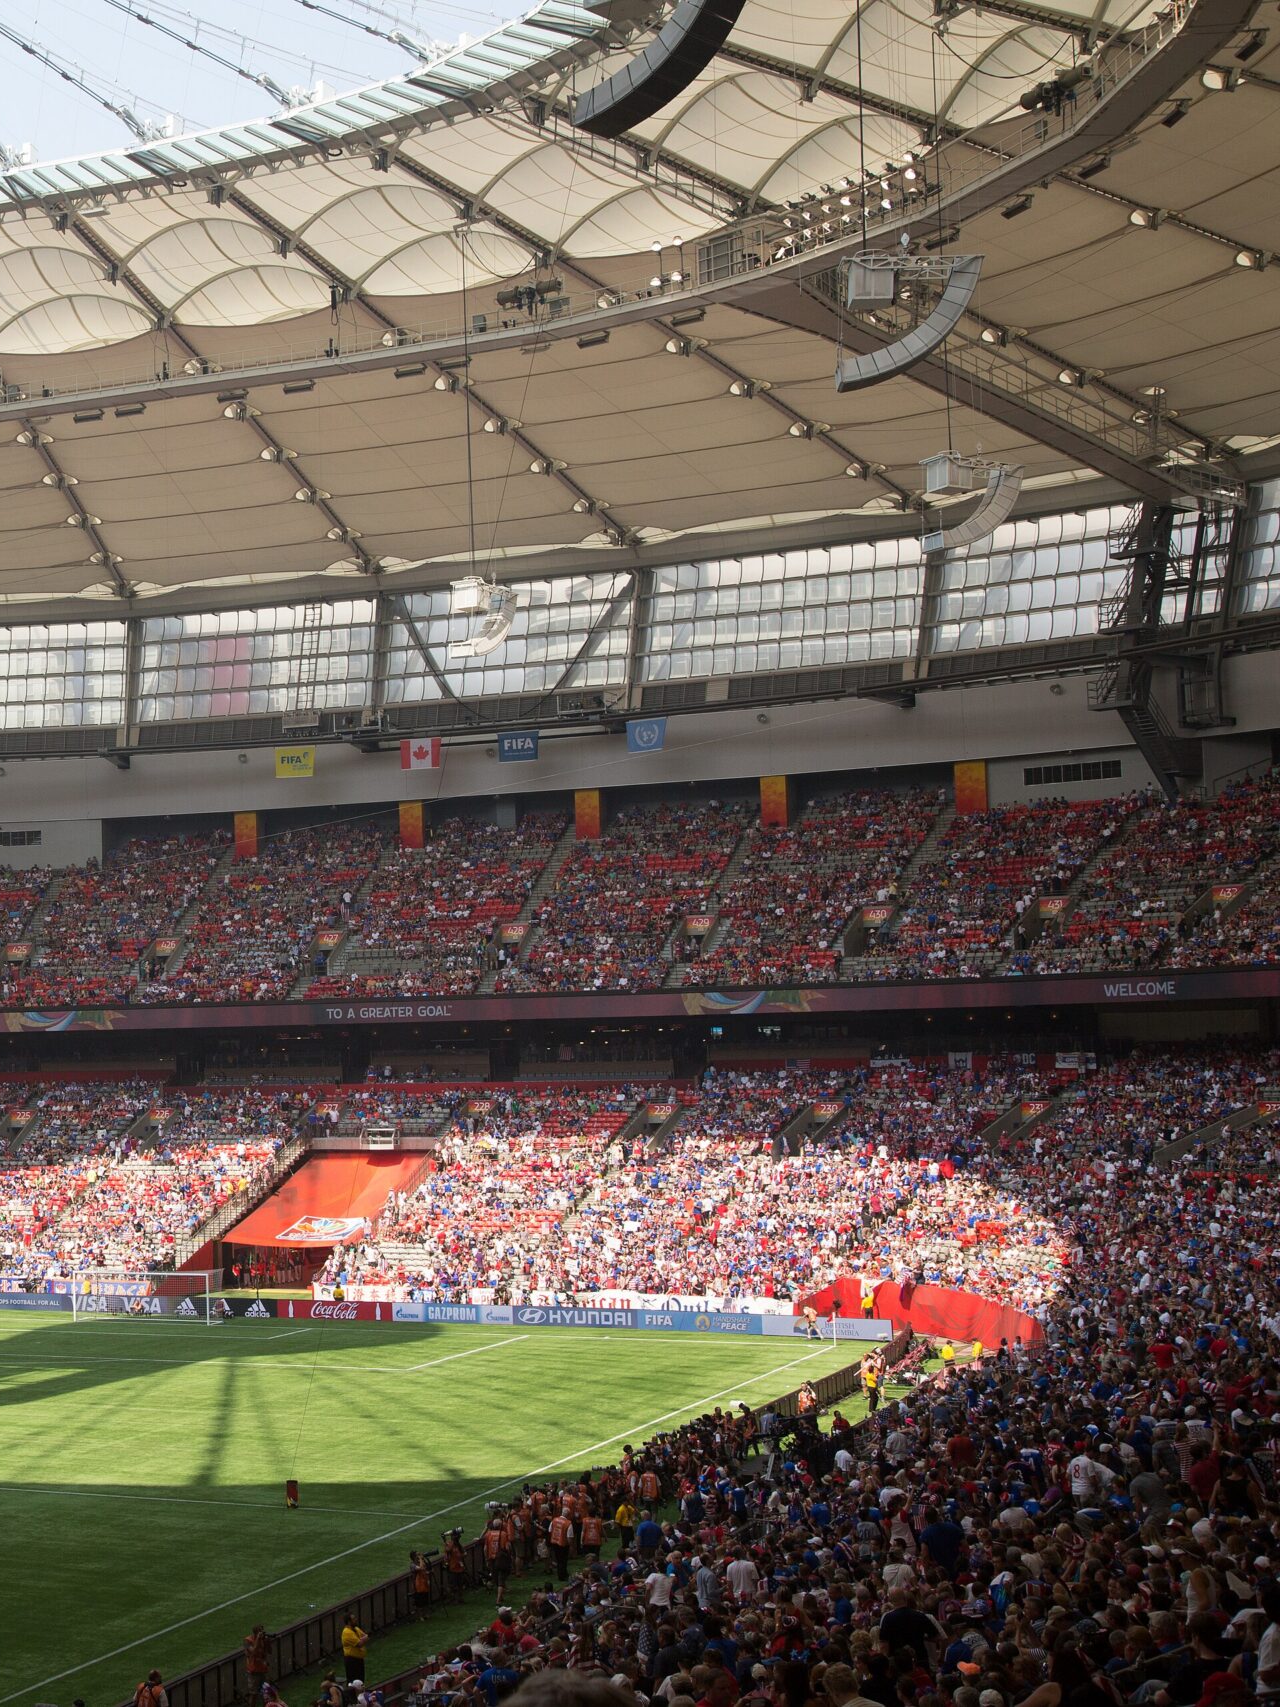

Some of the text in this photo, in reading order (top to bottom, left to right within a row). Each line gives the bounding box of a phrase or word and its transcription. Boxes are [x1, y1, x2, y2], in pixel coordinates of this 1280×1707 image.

[504, 737, 534, 750] FIFA
[280, 755, 302, 764] FIFA
[1047, 900, 1063, 908] 431
[869, 909, 887, 918] 430
[692, 918, 710, 926] 429
[507, 926, 524, 934] 428
[161, 941, 176, 949] 426
[1103, 981, 1176, 997] WELCOME
[326, 1008, 342, 1019] TO
[347, 1008, 355, 1018] A
[360, 1006, 413, 1018] GREATER
[474, 1102, 490, 1110] 228
[654, 1105, 672, 1114] 229
[820, 1104, 838, 1113] 230
[1029, 1103, 1044, 1112] 231
[155, 1110, 170, 1118] 226
[68, 1296, 108, 1311] VISA
[428, 1306, 476, 1321] GAZPROM
[549, 1309, 632, 1326] HYUNDAI
[645, 1314, 673, 1326] FIFA
[713, 1316, 751, 1324] HANDSHAKE
[721, 1323, 747, 1331] PEACE
[1073, 1464, 1081, 1479] 8
[491, 1674, 506, 1684] USA
